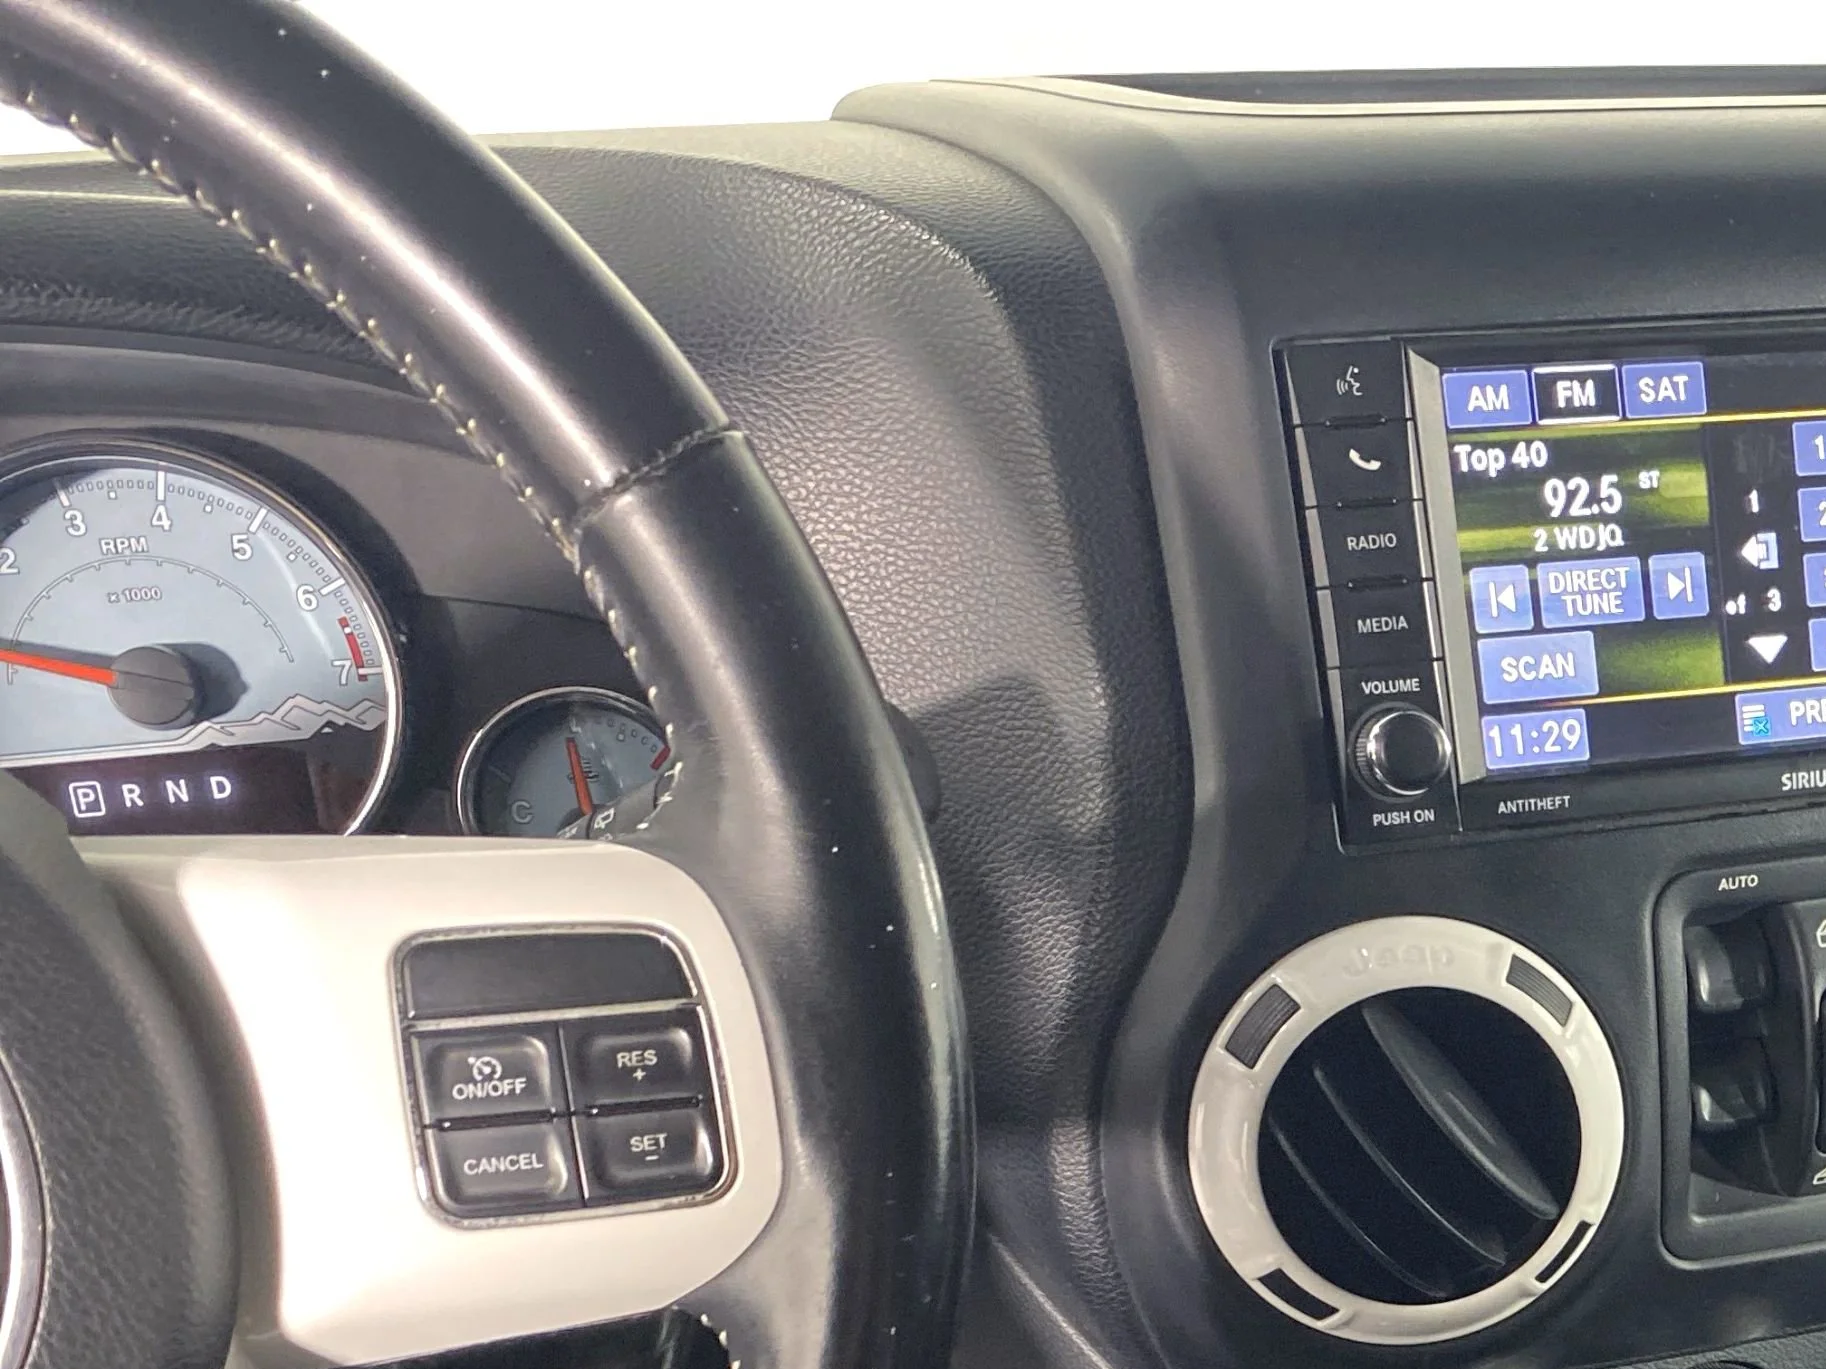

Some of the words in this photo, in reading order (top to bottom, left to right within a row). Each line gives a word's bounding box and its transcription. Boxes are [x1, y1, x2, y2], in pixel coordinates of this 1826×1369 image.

[1467, 383, 1509, 412] AM
[1556, 379, 1596, 408] FM
[1638, 374, 1689, 403] SAT
[1454, 443, 1505, 477] Top
[1511, 440, 1548, 469] 40
[1814, 434, 1826, 460] 1
[1543, 474, 1623, 518] 92.5
[1639, 470, 1660, 490] ST
[1747, 490, 1759, 513] 1
[63, 509, 87, 537] 3
[150, 505, 172, 532] 4
[99, 535, 150, 557] RPM
[231, 533, 253, 562] 5
[1347, 532, 1397, 552] RADIO
[1533, 528, 1549, 553] 2
[0, 547, 20, 575] 2
[122, 584, 163, 603] 1000
[1548, 566, 1630, 596] DIRECT
[295, 585, 319, 611] 6
[1562, 592, 1624, 618] TUNE
[1725, 592, 1746, 616] of
[1767, 588, 1783, 612] 3
[1357, 614, 1409, 634] MEDIA
[332, 659, 354, 687] 7
[1501, 652, 1576, 683] SCAN
[1361, 677, 1421, 696] VOLUME
[1488, 717, 1583, 758] 11:29
[77, 788, 97, 810] P
[122, 784, 144, 808] R
[164, 779, 190, 804] N
[210, 774, 233, 800] D
[1497, 795, 1571, 815] ANTITHEFT
[511, 800, 534, 824] C
[1373, 810, 1411, 827] PUSH
[1414, 808, 1435, 824] ON
[1717, 873, 1759, 892] AUTO
[616, 1049, 658, 1068] RES
[452, 1077, 527, 1100] ON/OFF
[630, 1132, 668, 1152] SET
[463, 1152, 544, 1176] CANCEL
